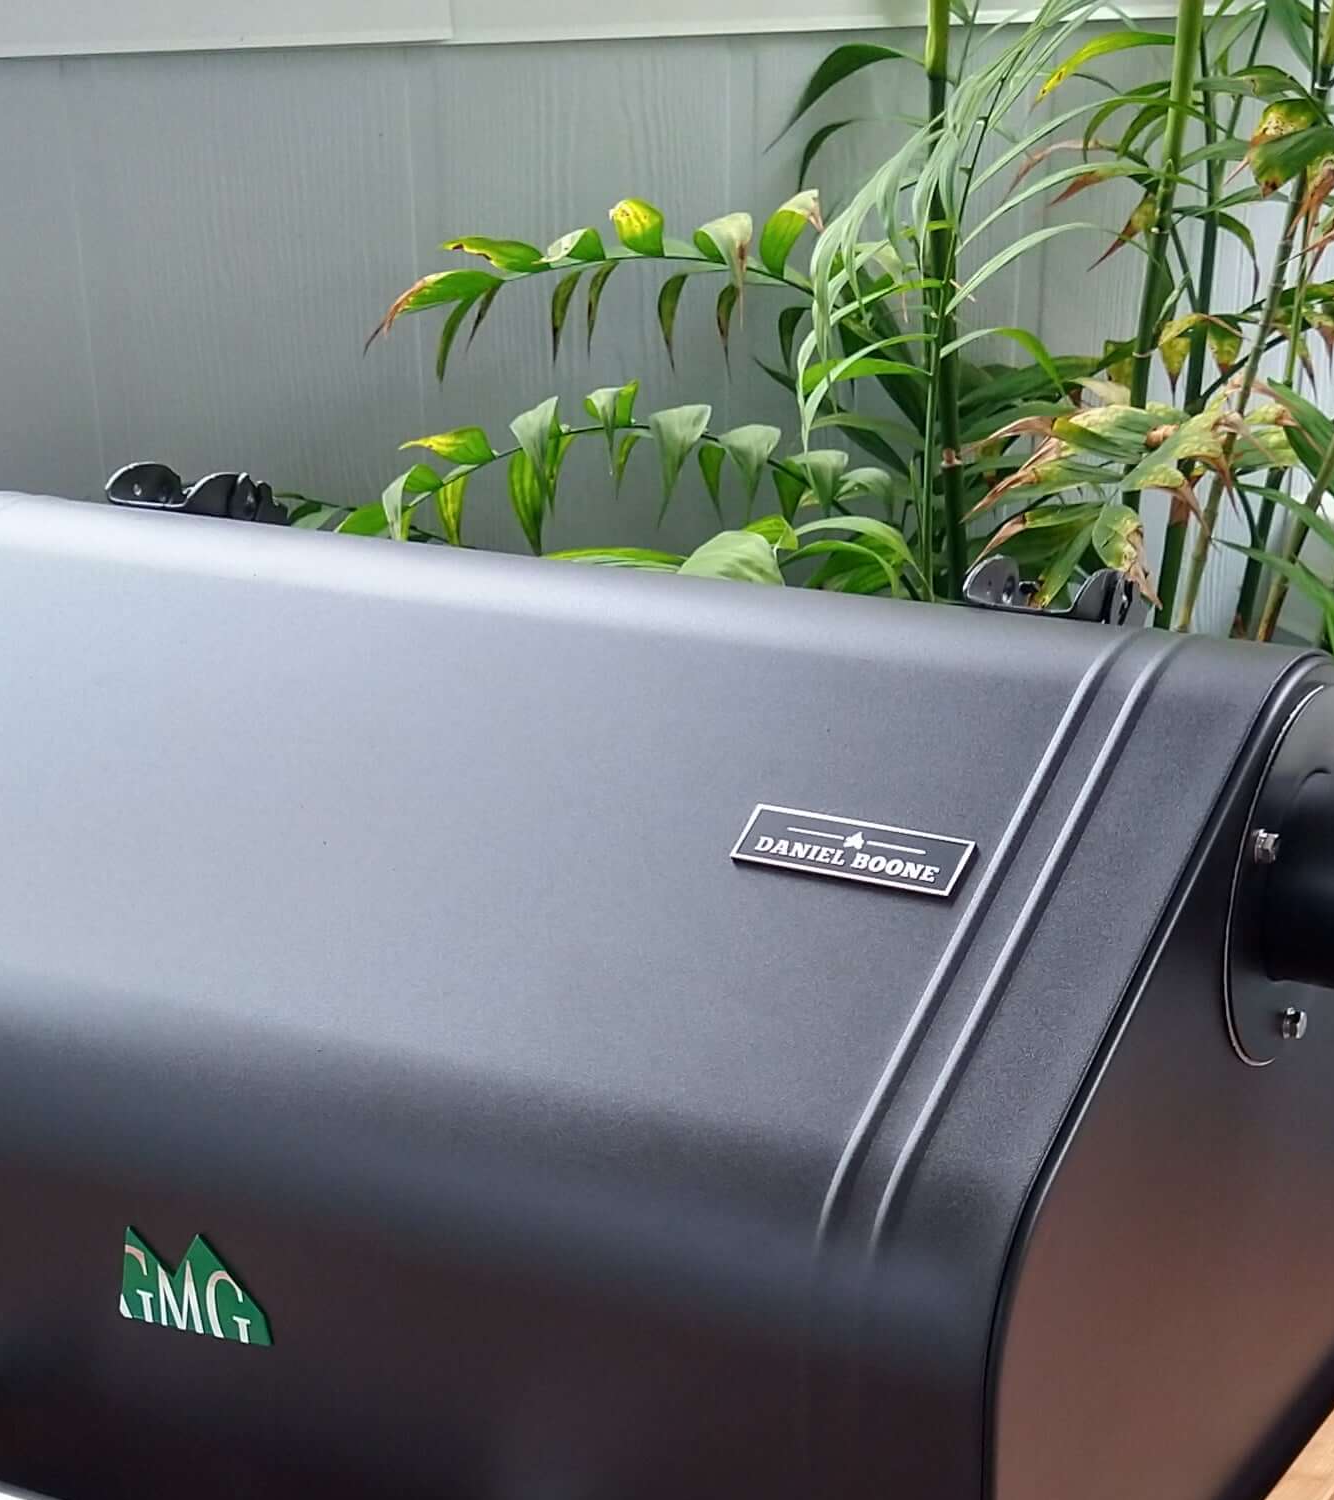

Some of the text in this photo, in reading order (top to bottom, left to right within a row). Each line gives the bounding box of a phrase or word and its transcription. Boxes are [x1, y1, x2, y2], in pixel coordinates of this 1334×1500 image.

[753, 835, 941, 883] DANIEL BOONE
[119, 1243, 250, 1345] GMG
